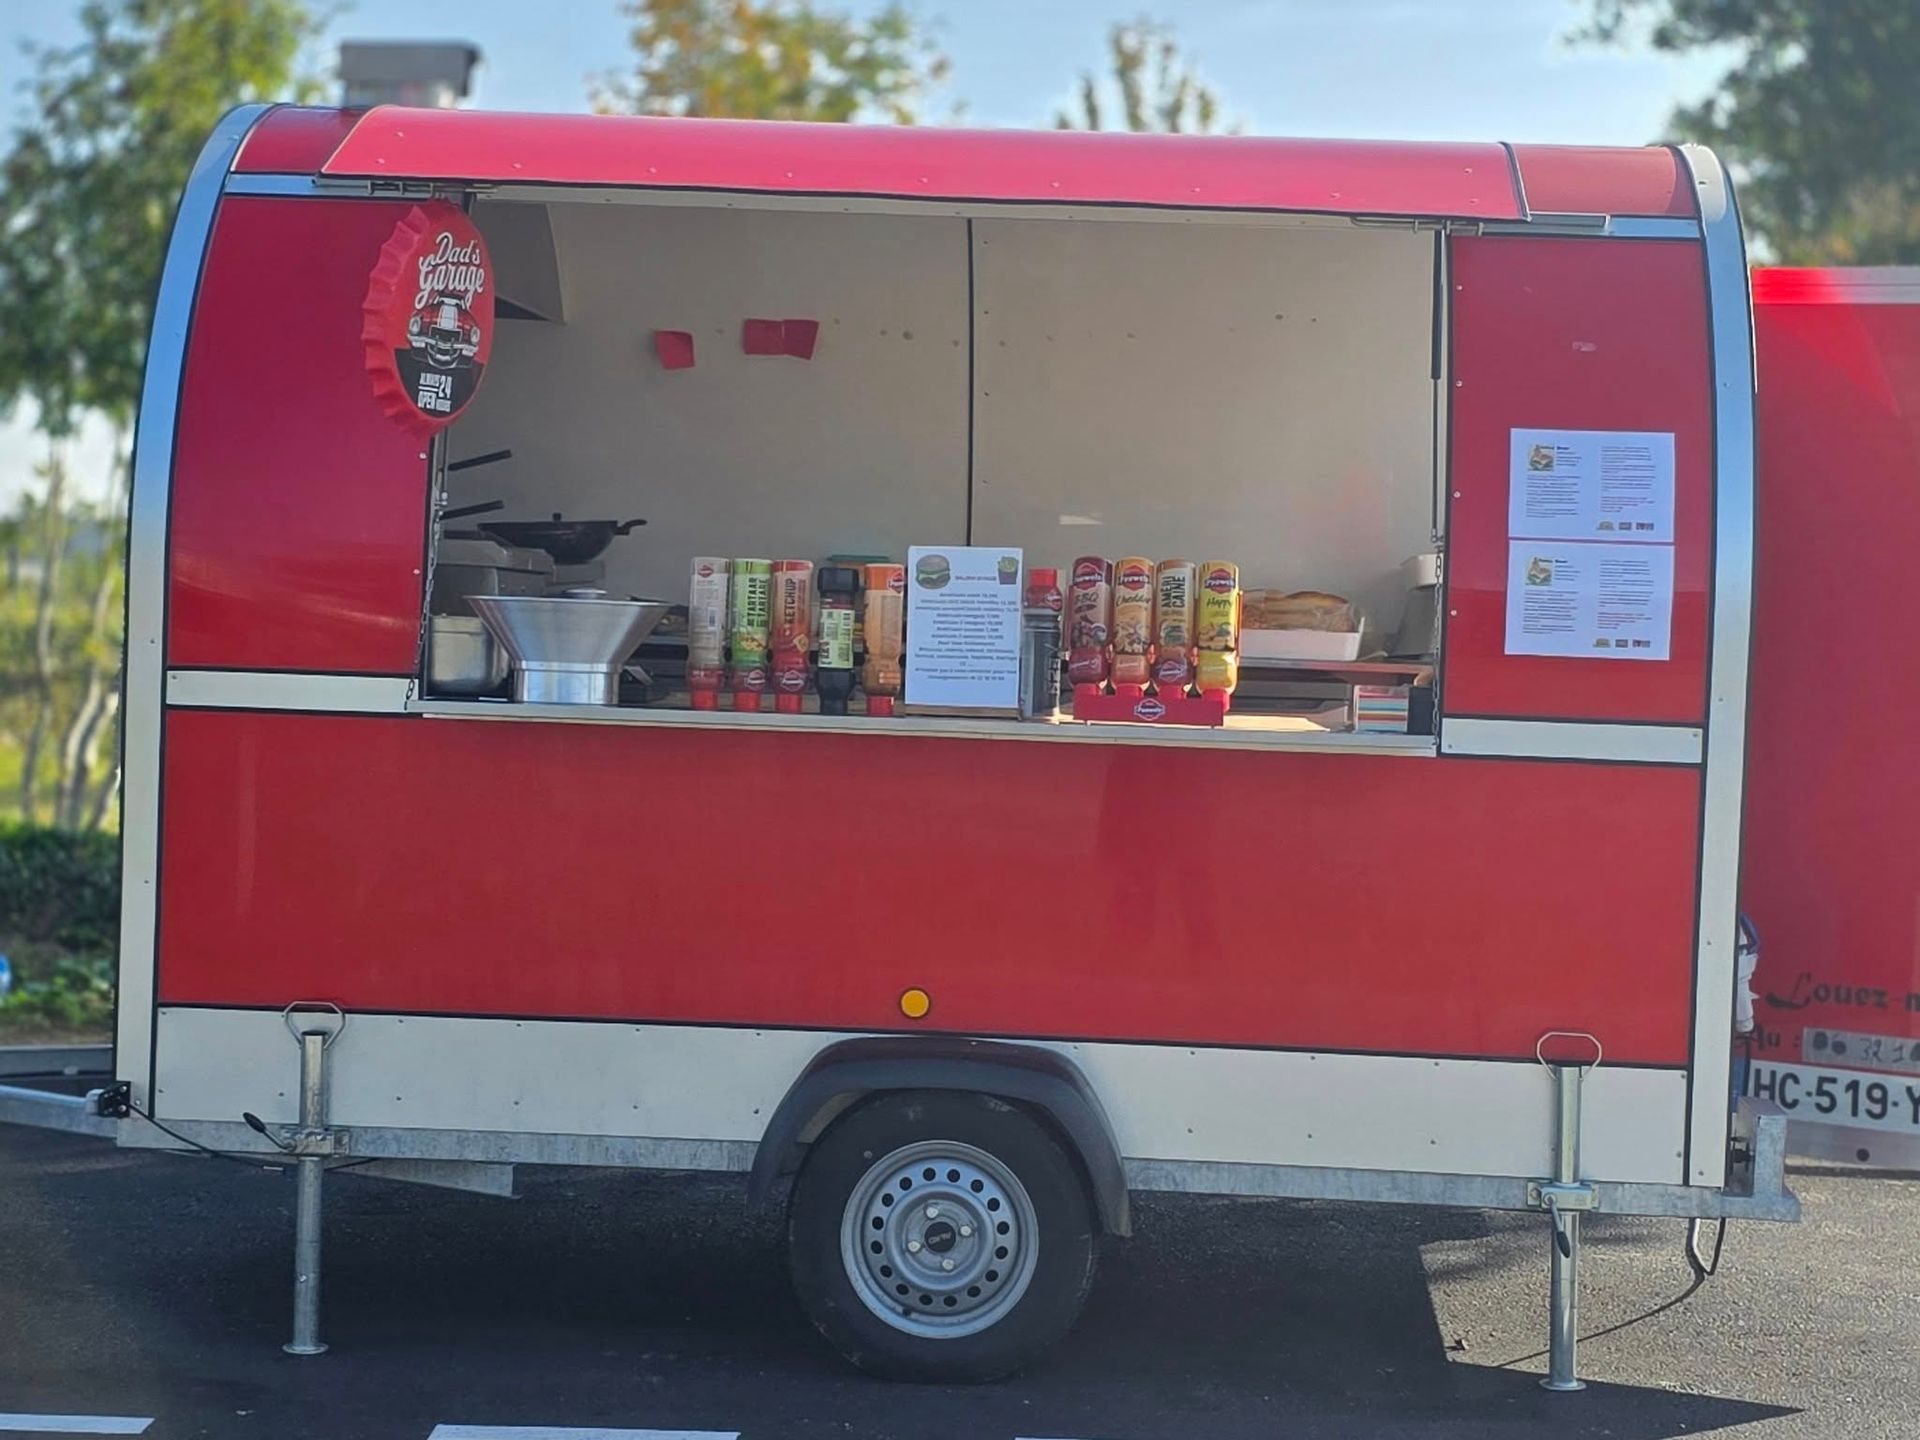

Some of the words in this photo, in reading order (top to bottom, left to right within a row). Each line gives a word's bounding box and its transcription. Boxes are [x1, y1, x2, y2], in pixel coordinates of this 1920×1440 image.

[433, 231, 480, 266] Dad's
[415, 255, 485, 310] Garage
[784, 578, 796, 625] KETCHUP
